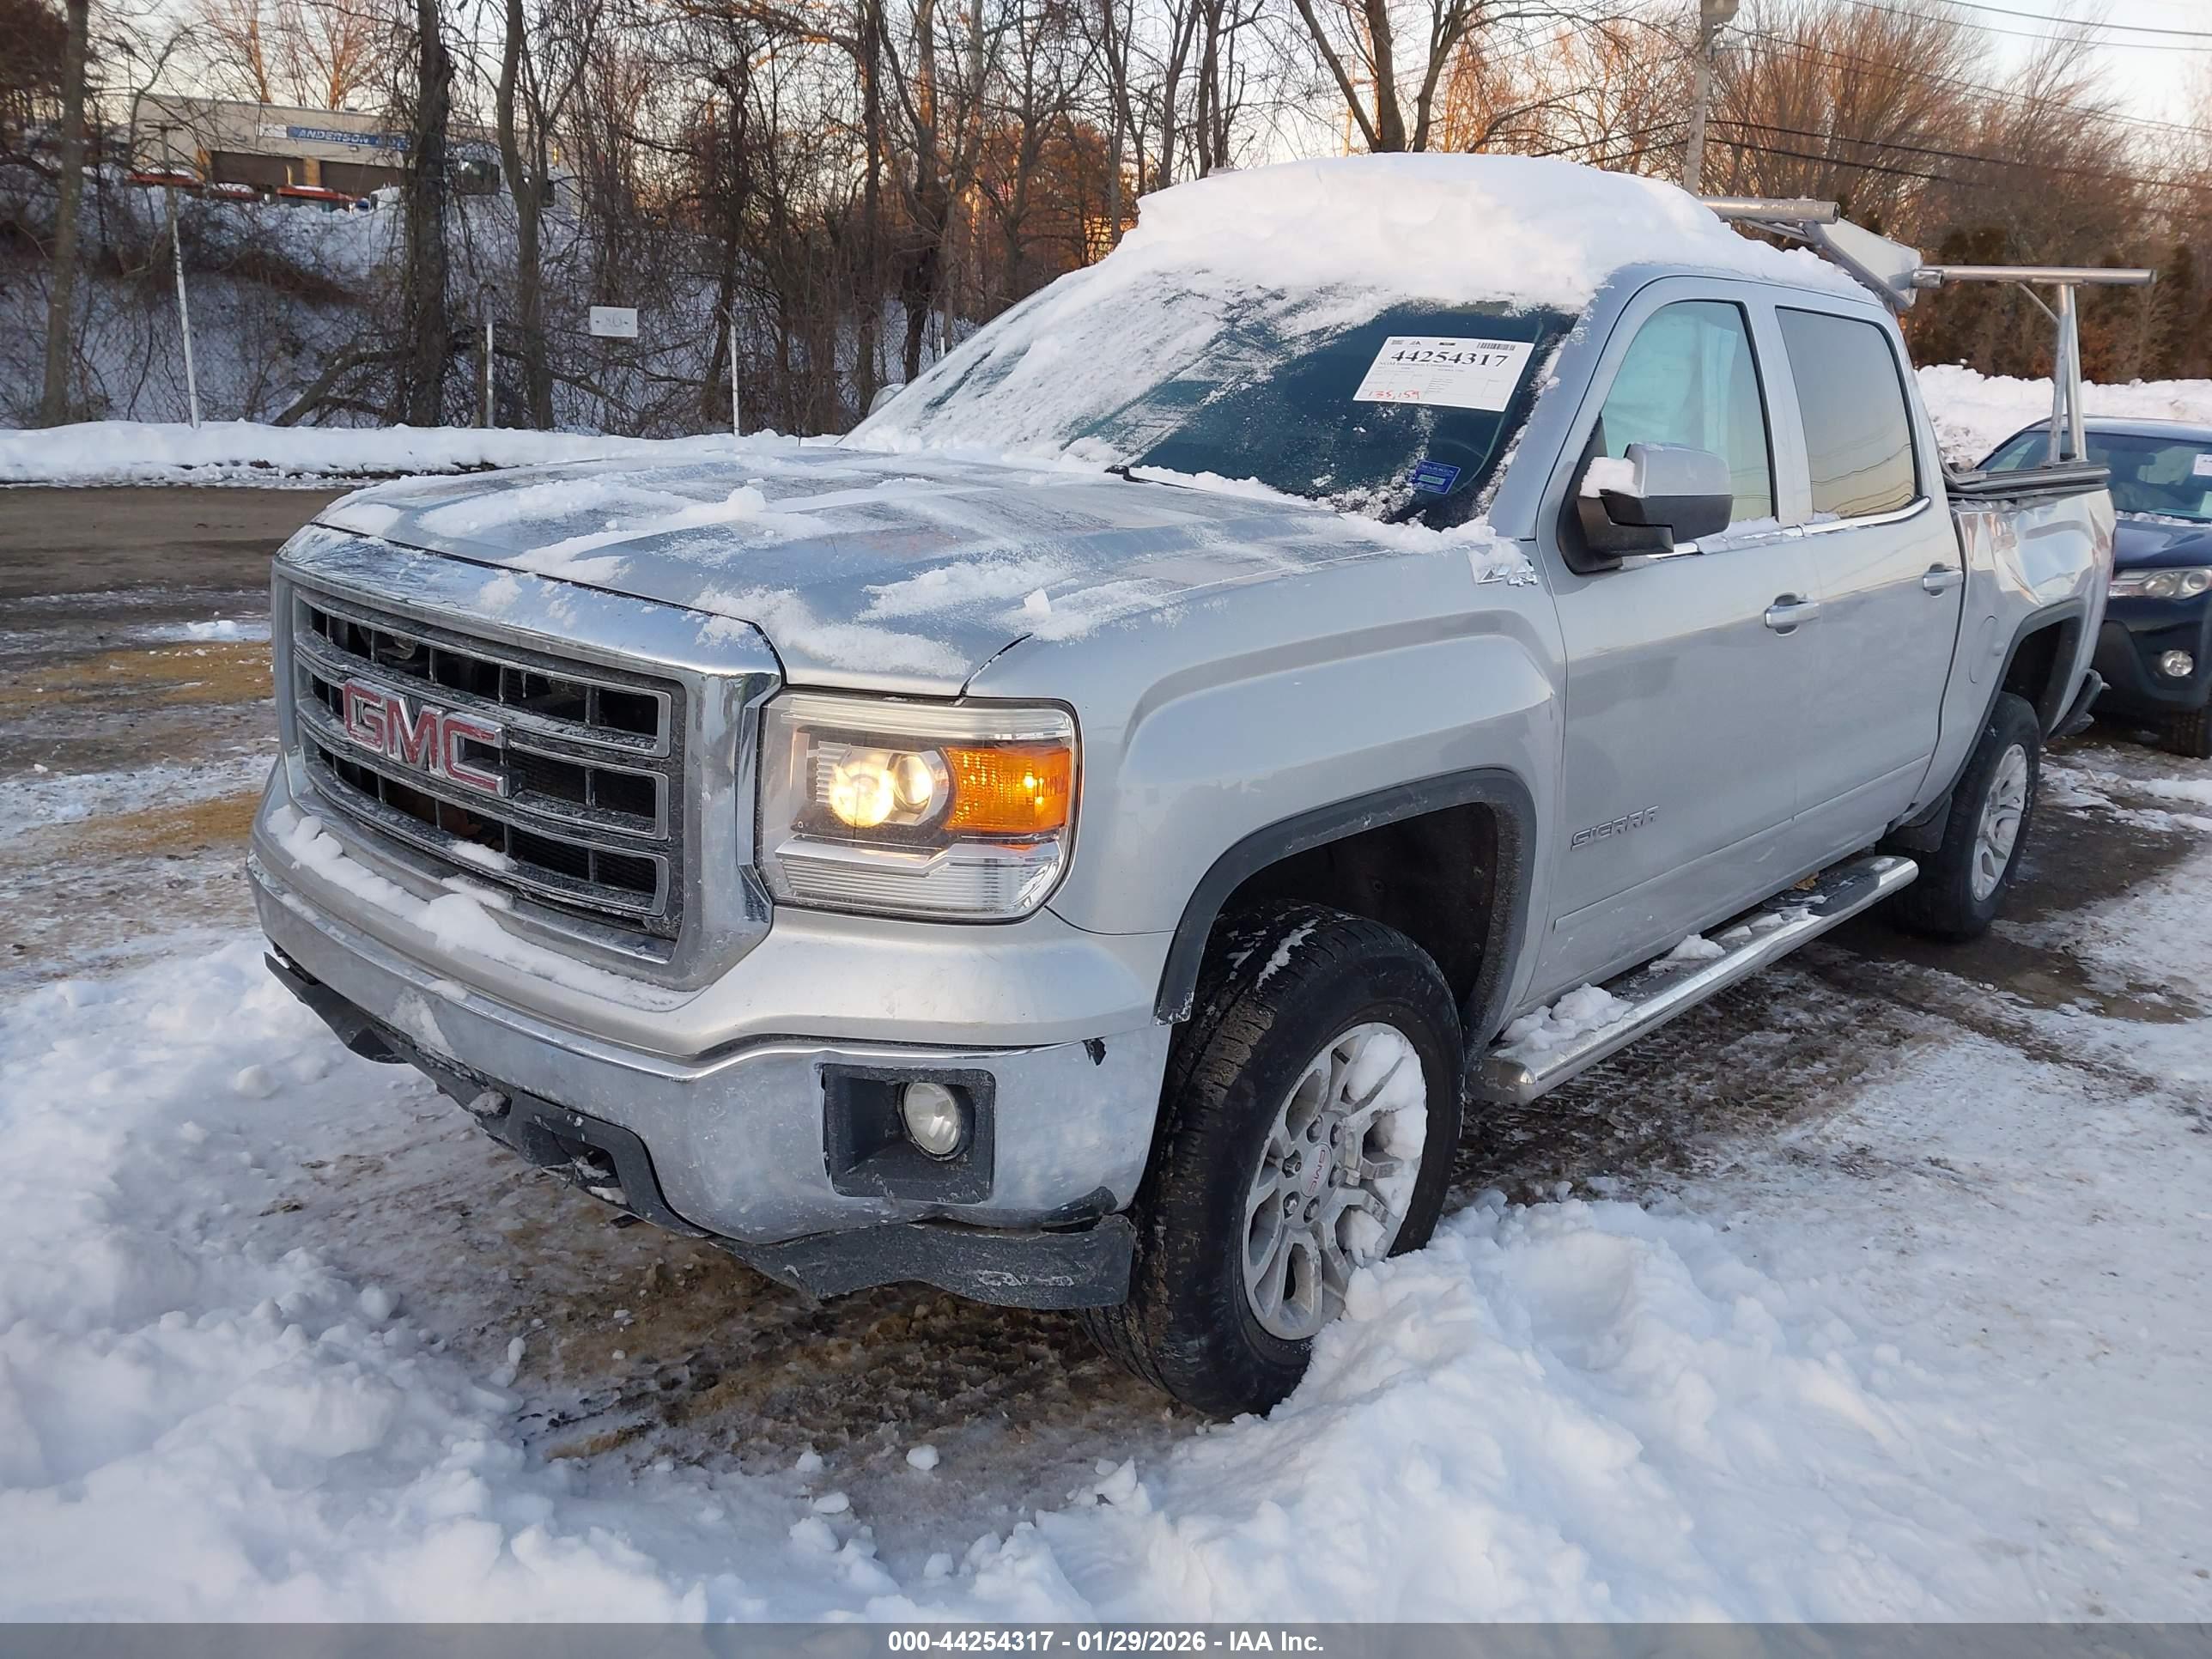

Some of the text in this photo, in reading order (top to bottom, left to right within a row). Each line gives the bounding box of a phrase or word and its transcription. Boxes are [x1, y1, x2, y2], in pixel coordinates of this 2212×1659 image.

[298, 129, 369, 144] ANDERSON
[1390, 349, 1510, 368] 44254317
[343, 677, 509, 798] GMC
[1571, 805, 1660, 851] SIERRA
[1308, 1149, 1326, 1194] GMC
